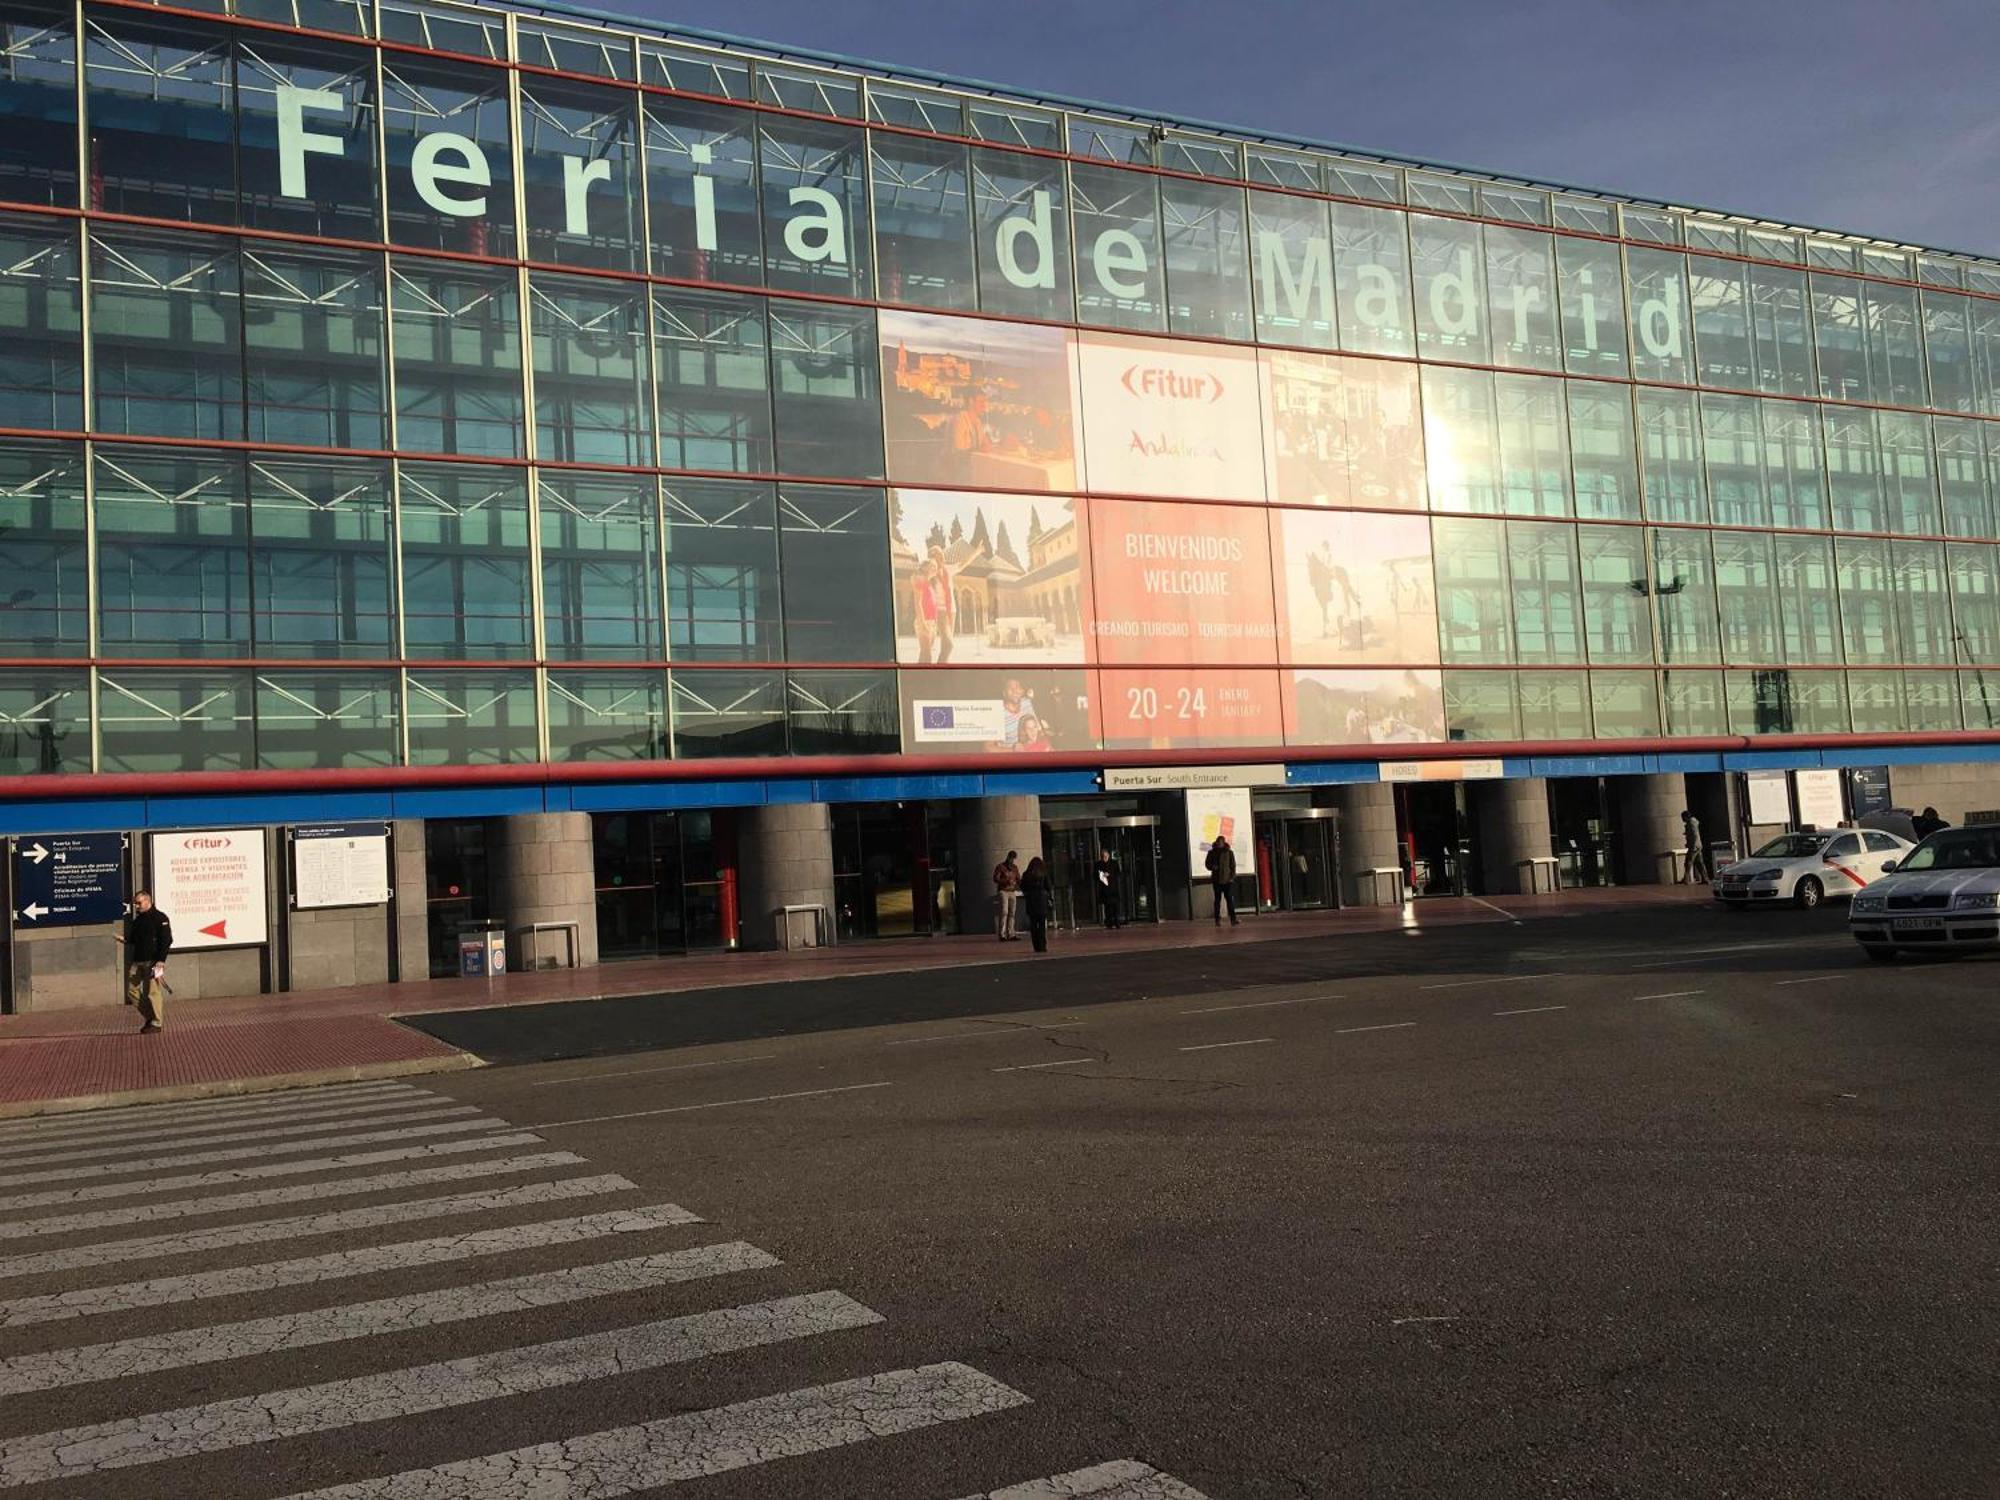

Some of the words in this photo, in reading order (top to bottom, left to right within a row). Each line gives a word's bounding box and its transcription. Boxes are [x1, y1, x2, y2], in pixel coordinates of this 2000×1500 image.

[276, 86, 848, 264] Feria
[996, 191, 1148, 299] de
[1260, 231, 1682, 358] Madrid
[1142, 369, 1206, 399] Fitur
[1125, 533, 1242, 561] BIENVENIDOS
[1144, 571, 1230, 595] WELCOME
[1142, 622, 1188, 637] TURISMO
[1127, 687, 1158, 719] 20
[1178, 687, 1208, 719] 24
[1114, 776, 1144, 785] Puerta
[1147, 775, 1162, 784] Sur
[1167, 774, 1191, 784] South
[1193, 773, 1229, 783] Entrance
[193, 839, 222, 849] Fitur
